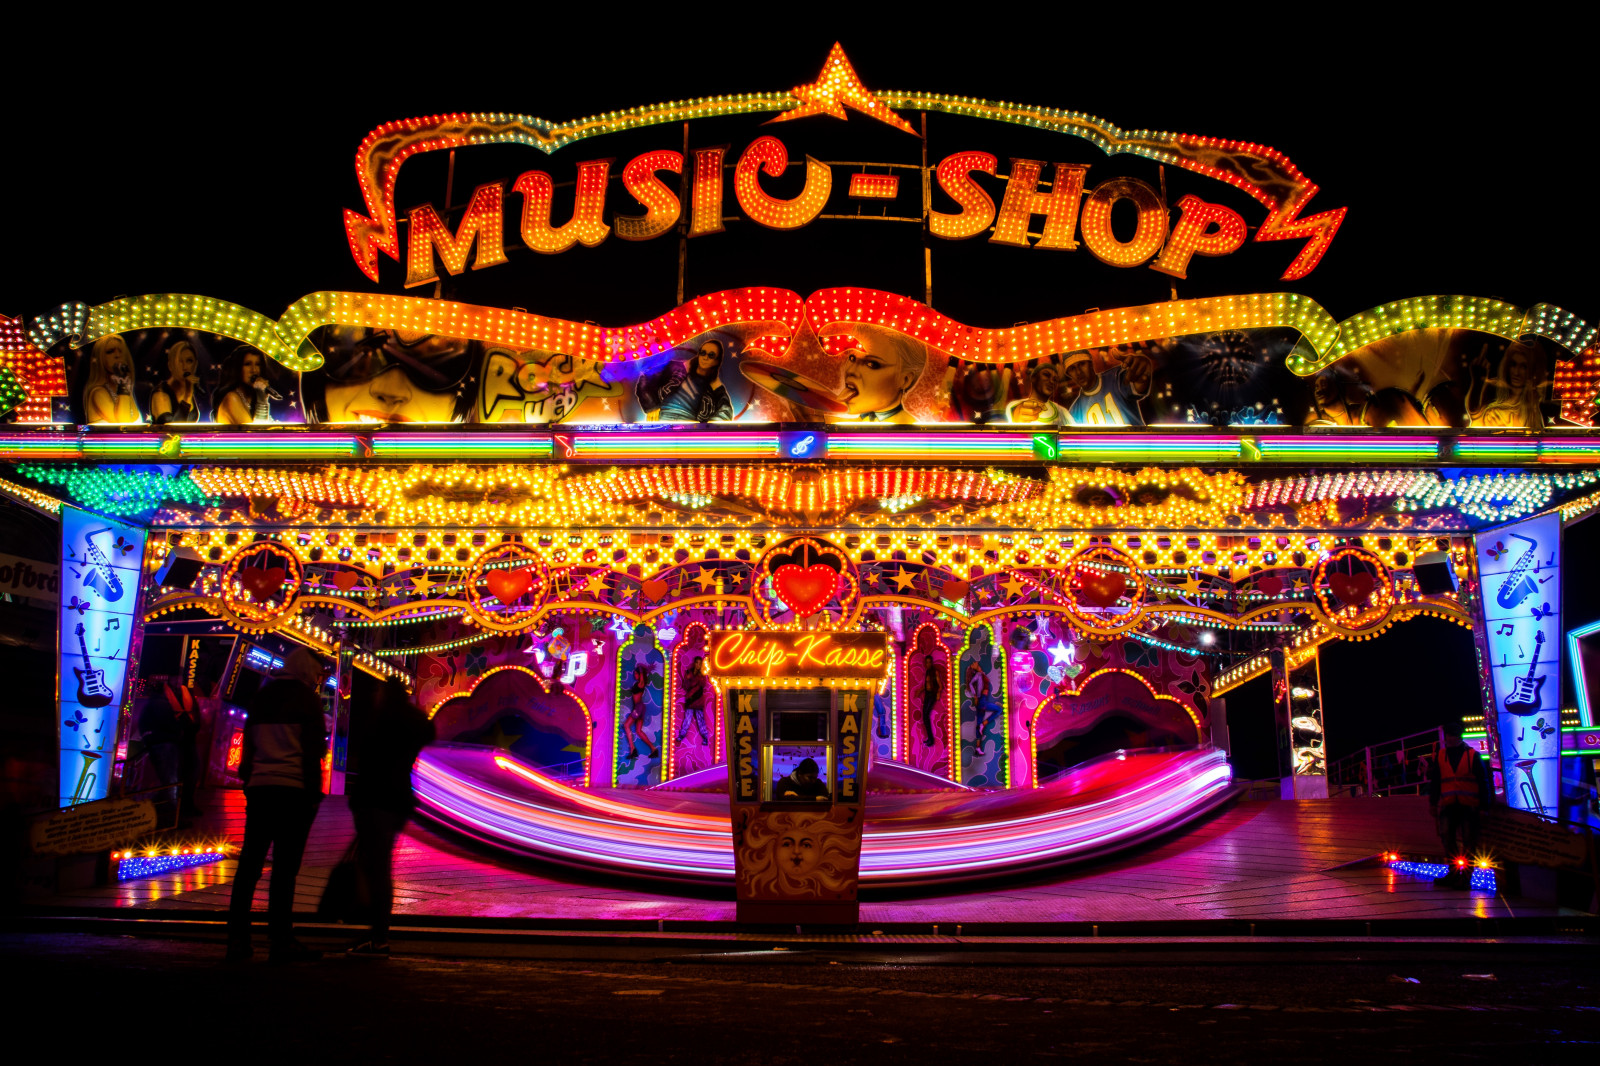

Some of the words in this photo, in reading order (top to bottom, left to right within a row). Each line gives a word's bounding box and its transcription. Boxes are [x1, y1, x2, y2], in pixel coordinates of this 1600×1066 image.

[187, 639, 201, 689] KASSE
[226, 643, 247, 695] KASSE
[736, 694, 755, 797] KASSE
[840, 694, 859, 798] KASSE
